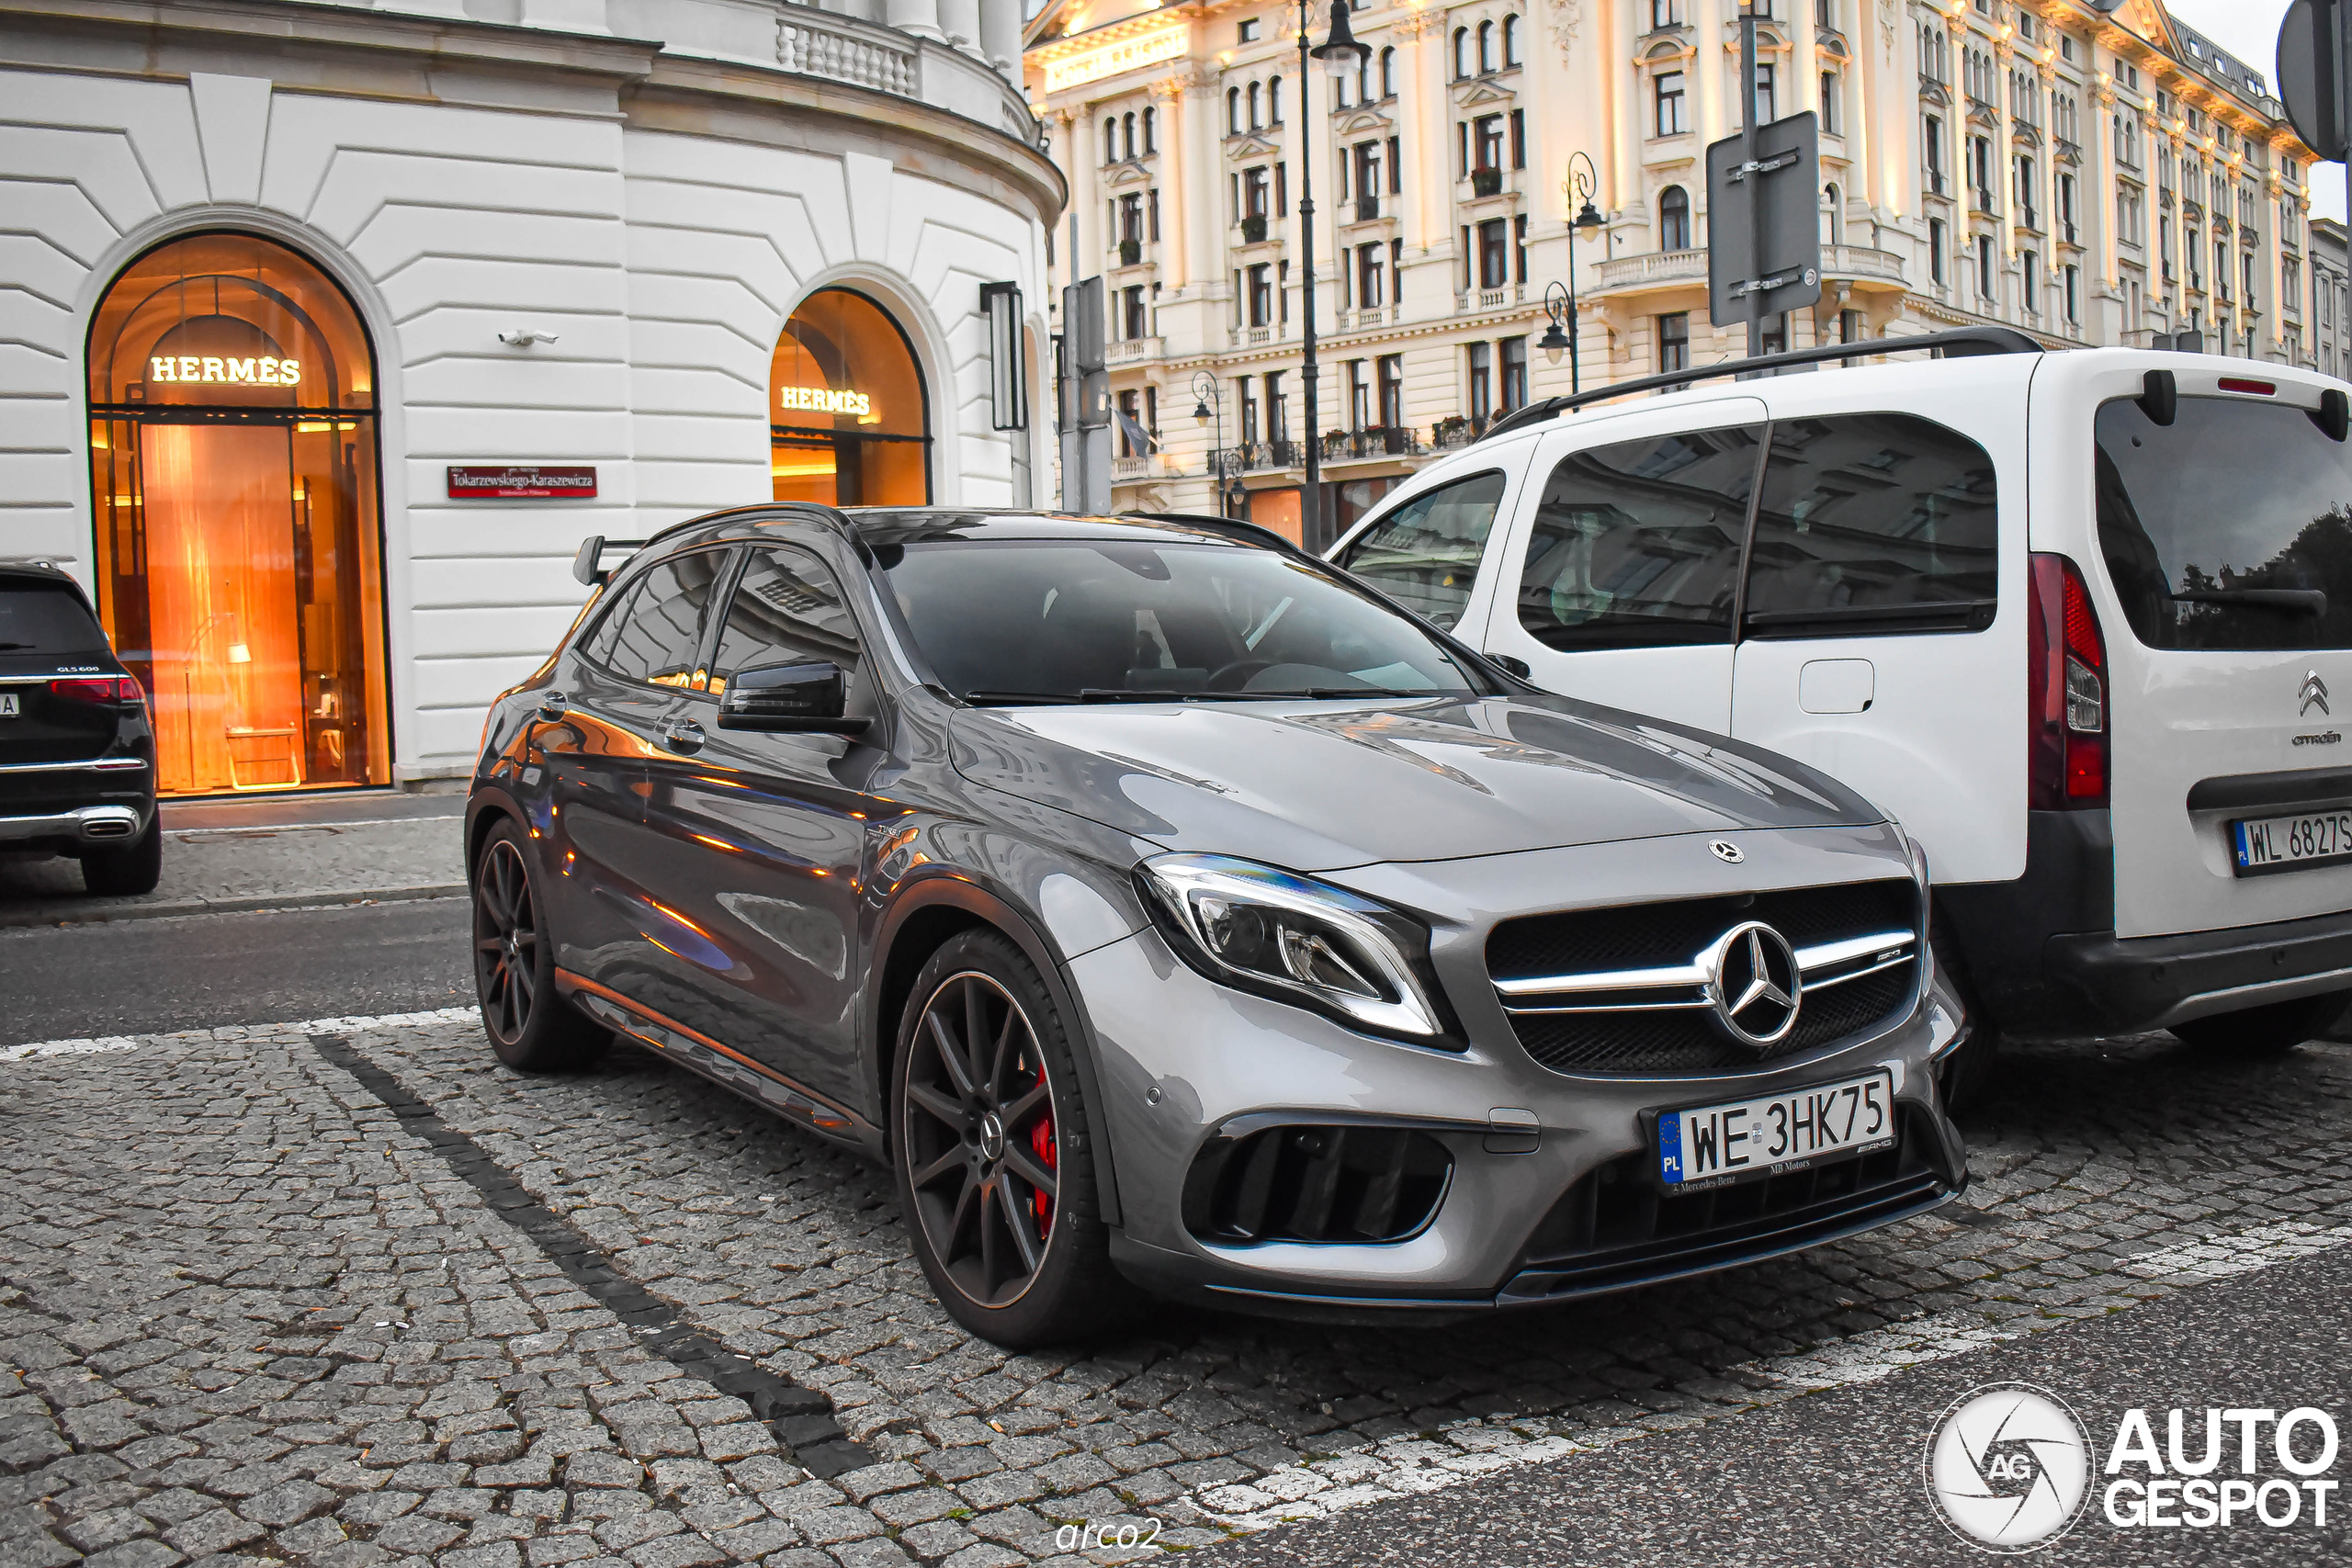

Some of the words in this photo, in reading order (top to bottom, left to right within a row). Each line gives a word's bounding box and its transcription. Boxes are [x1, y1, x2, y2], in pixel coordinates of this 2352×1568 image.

[2249, 822, 2282, 863] WL
[2290, 815, 2352, 858] 6827S
[2238, 851, 2247, 862] PL
[1690, 1107, 1750, 1174] WE
[1766, 1080, 1883, 1157] 3HK75
[1663, 1156, 1680, 1173] PL
[1770, 1165, 1783, 1176] MB
[1784, 1159, 1811, 1171] Motors
[1680, 1176, 1736, 1193] Mercedes-Benz
